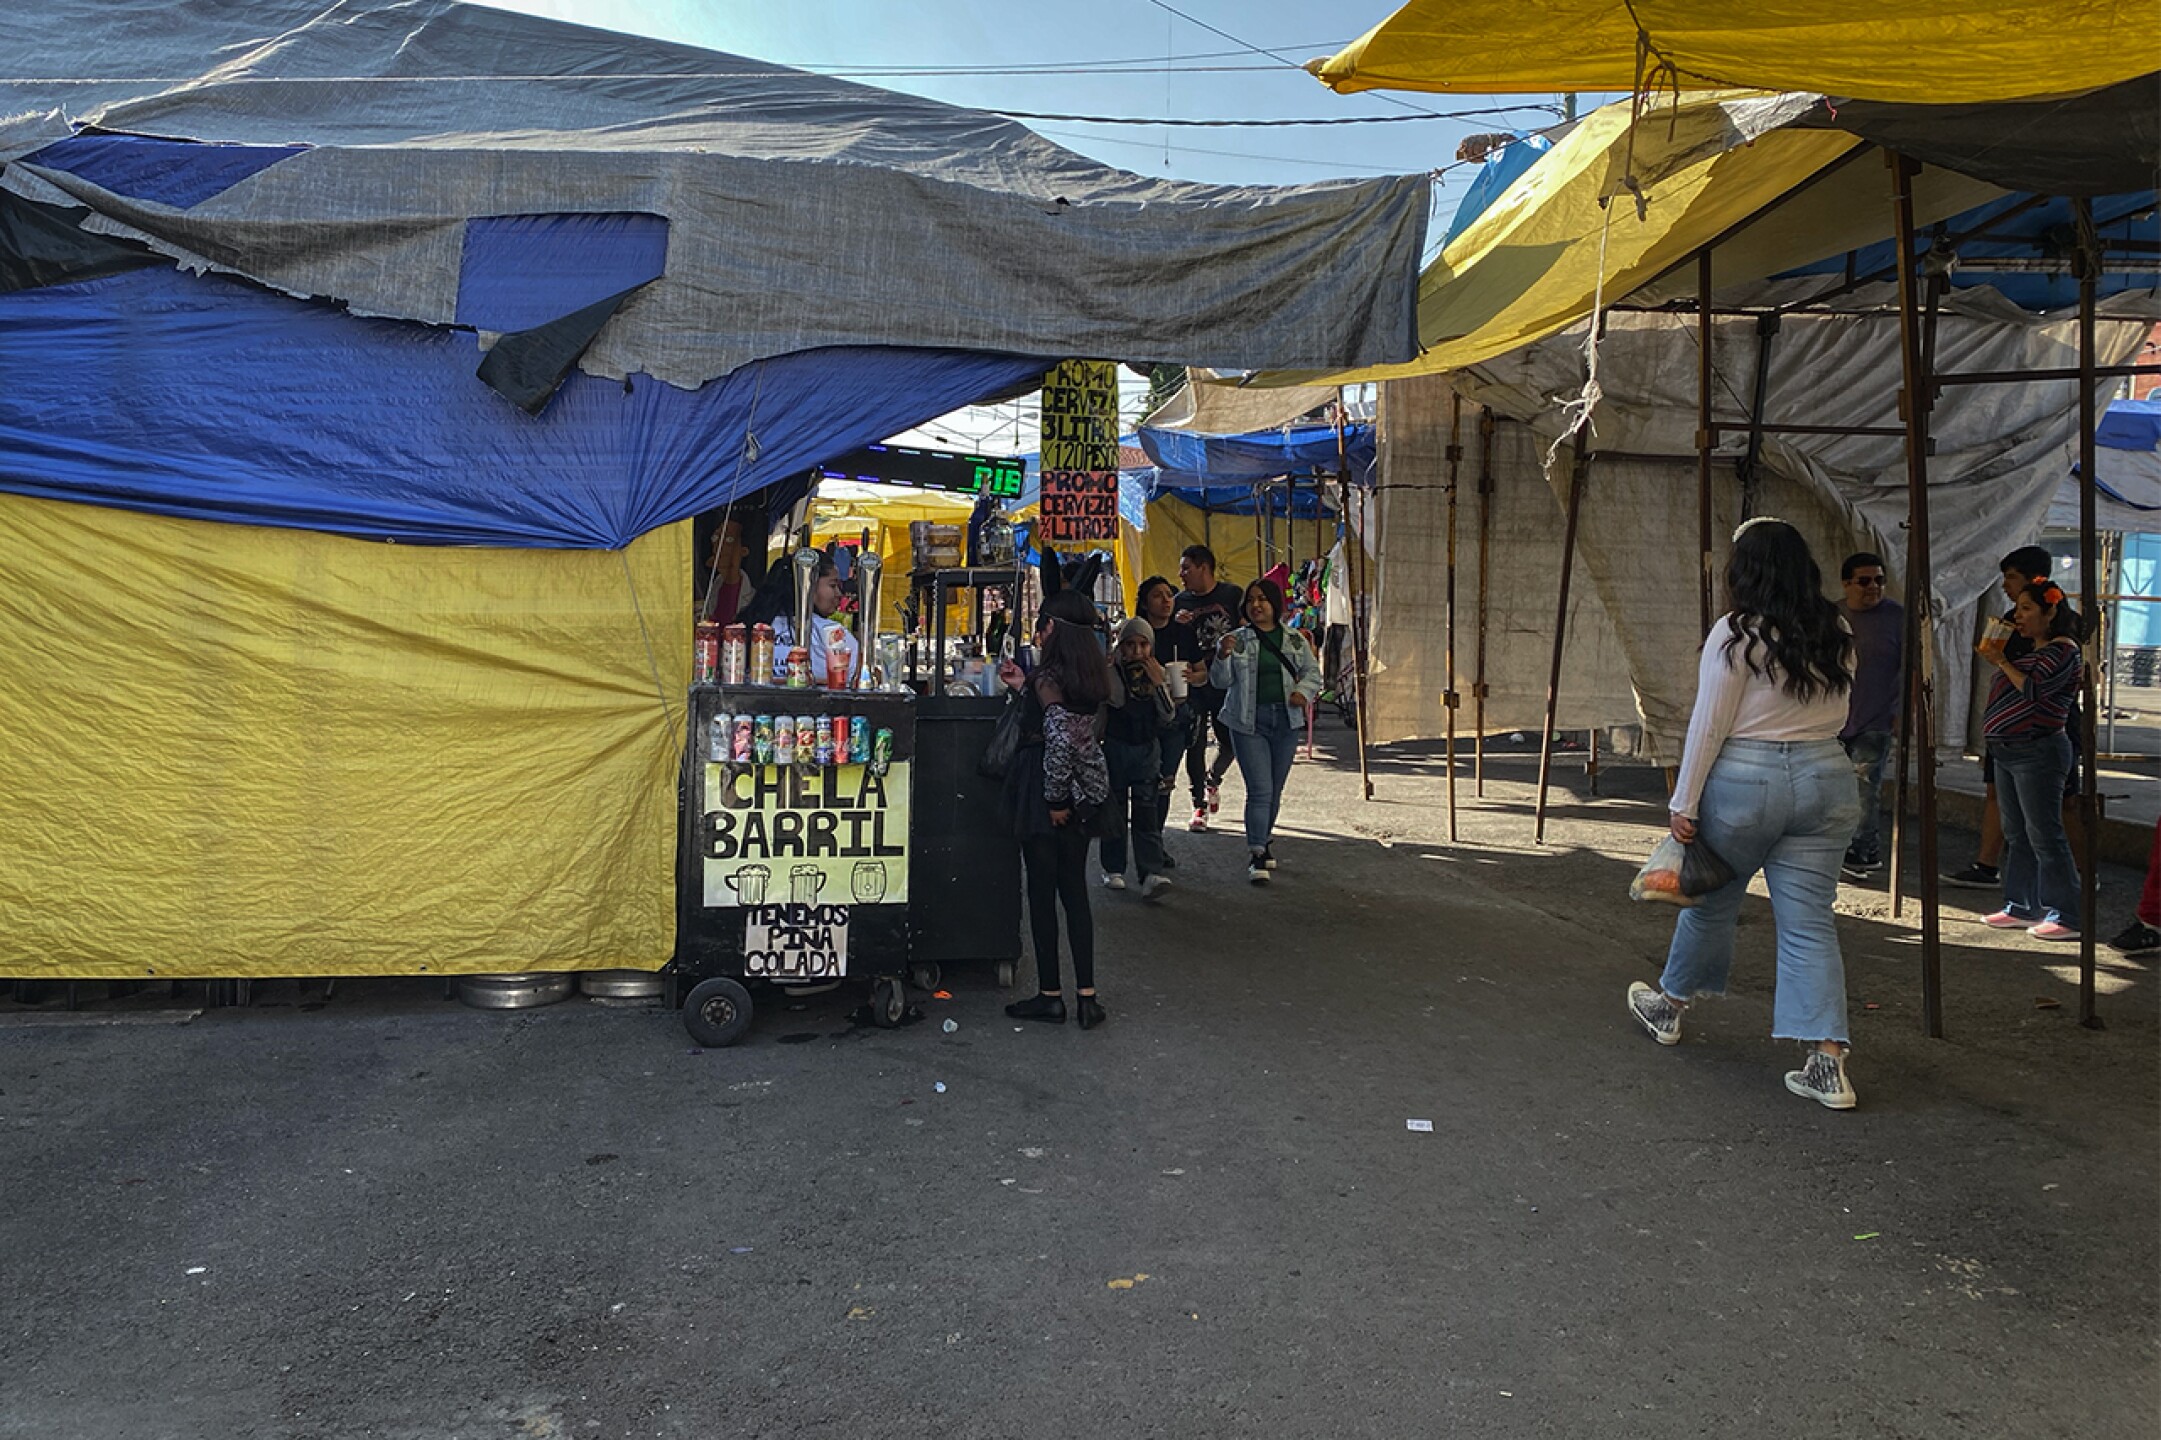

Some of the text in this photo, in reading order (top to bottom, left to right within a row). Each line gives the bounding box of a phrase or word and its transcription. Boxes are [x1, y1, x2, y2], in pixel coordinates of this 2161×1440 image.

[1041, 386, 1119, 416] CERVEZA
[1041, 471, 1119, 494] PROMO
[1041, 494, 1116, 516] CERVEZA
[720, 763, 888, 810] CHELA
[703, 811, 905, 859] BARRIL
[746, 903, 849, 927] TENEMOS
[746, 950, 840, 976] COLADA
